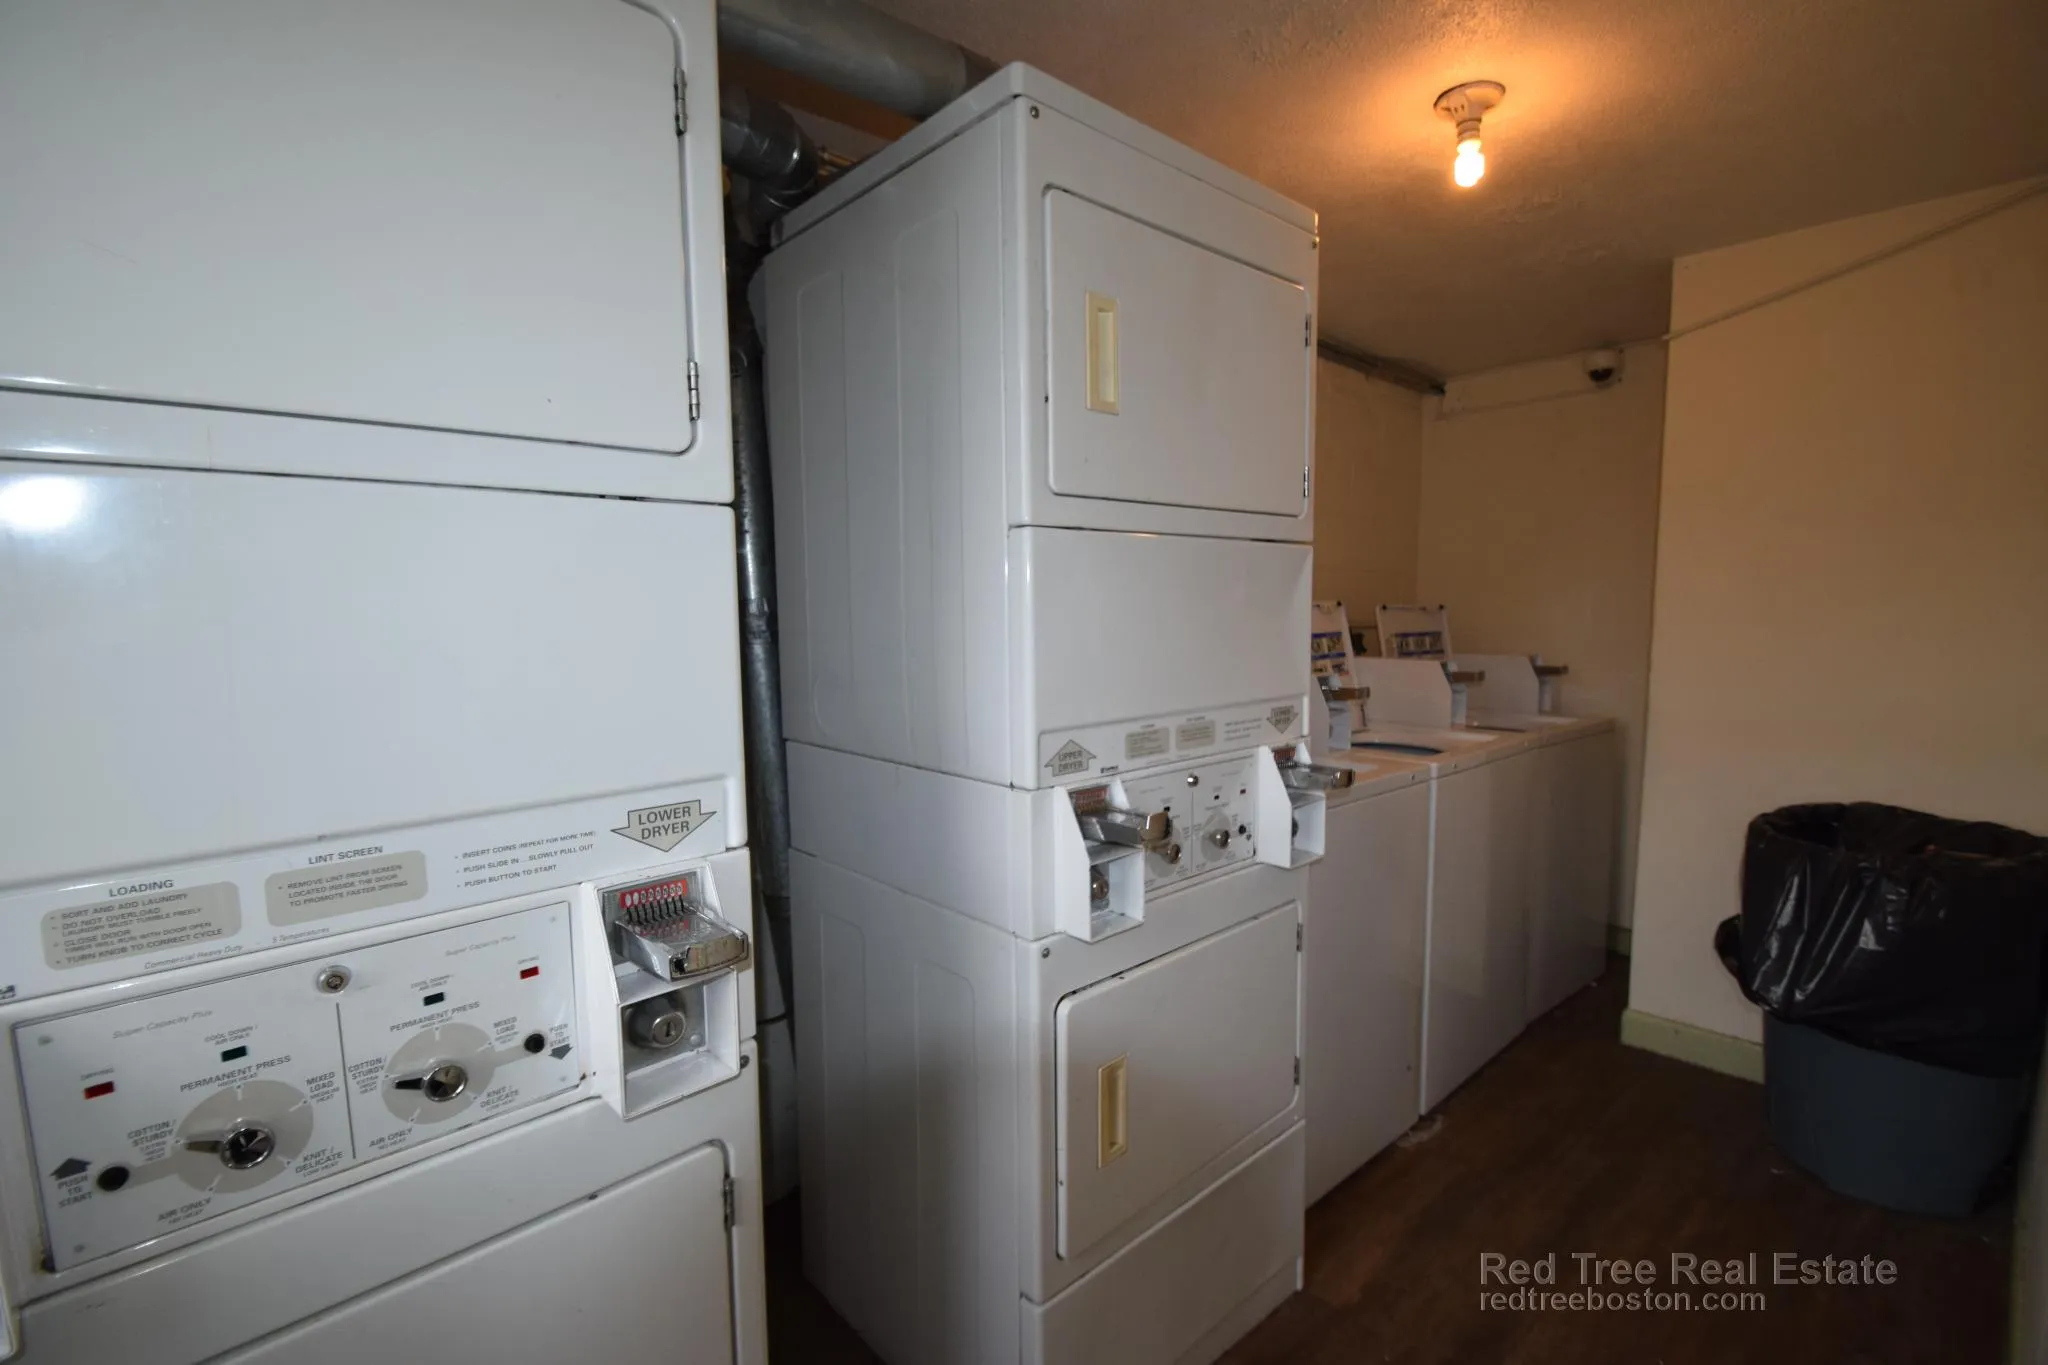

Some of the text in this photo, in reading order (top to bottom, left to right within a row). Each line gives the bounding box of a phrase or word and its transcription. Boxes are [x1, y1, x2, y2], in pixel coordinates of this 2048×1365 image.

[638, 806, 691, 825] LOWER
[641, 821, 690, 840] DRYER
[308, 845, 383, 865] LINT SCREEN
[462, 848, 490, 859] INSERT
[492, 843, 517, 854] COINS
[463, 863, 486, 873] PUSH
[487, 859, 509, 869] SLIDE
[510, 857, 519, 865] IN
[559, 847, 577, 855] PULL
[578, 843, 594, 852] OUT
[287, 864, 403, 890] REMOVE LINT FROM SCREEN
[288, 873, 398, 899] LOCATED INSIDE THE DOOR
[464, 878, 487, 888] PUSH
[488, 871, 521, 883] BUTTON
[534, 864, 557, 874] START
[109, 879, 174, 898] LOADING
[290, 899, 302, 908] TO
[303, 892, 345, 905] PROMOTE
[346, 886, 377, 897] FASTER
[61, 893, 188, 920] SORT AND ADD LAUNDRY
[62, 907, 161, 930] DO NOT OVERLOAD
[64, 929, 131, 947] CLOSE DOOR
[66, 928, 223, 965] TURN KNOB TO CORRECT CYCLE
[144, 944, 244, 970] Commercial Heavy Duty
[112, 1009, 213, 1040] Super Capacity Plus
[389, 1001, 480, 1032] PERMANENT PRESS
[180, 1054, 291, 1092] PERMANENT PRESS
[306, 1071, 335, 1086] MIXED
[351, 1065, 385, 1081] STURDY
[310, 1080, 334, 1093] LOAD
[132, 1128, 174, 1147] STURDY
[369, 1126, 413, 1148] AIR ONLY
[295, 1151, 344, 1174] DELICATE
[303, 1148, 327, 1162] KNIT
[58, 1175, 88, 1190] PUSH
[68, 1187, 83, 1196] TO
[58, 1191, 93, 1208] START
[158, 1197, 212, 1222] AIR ONLY
